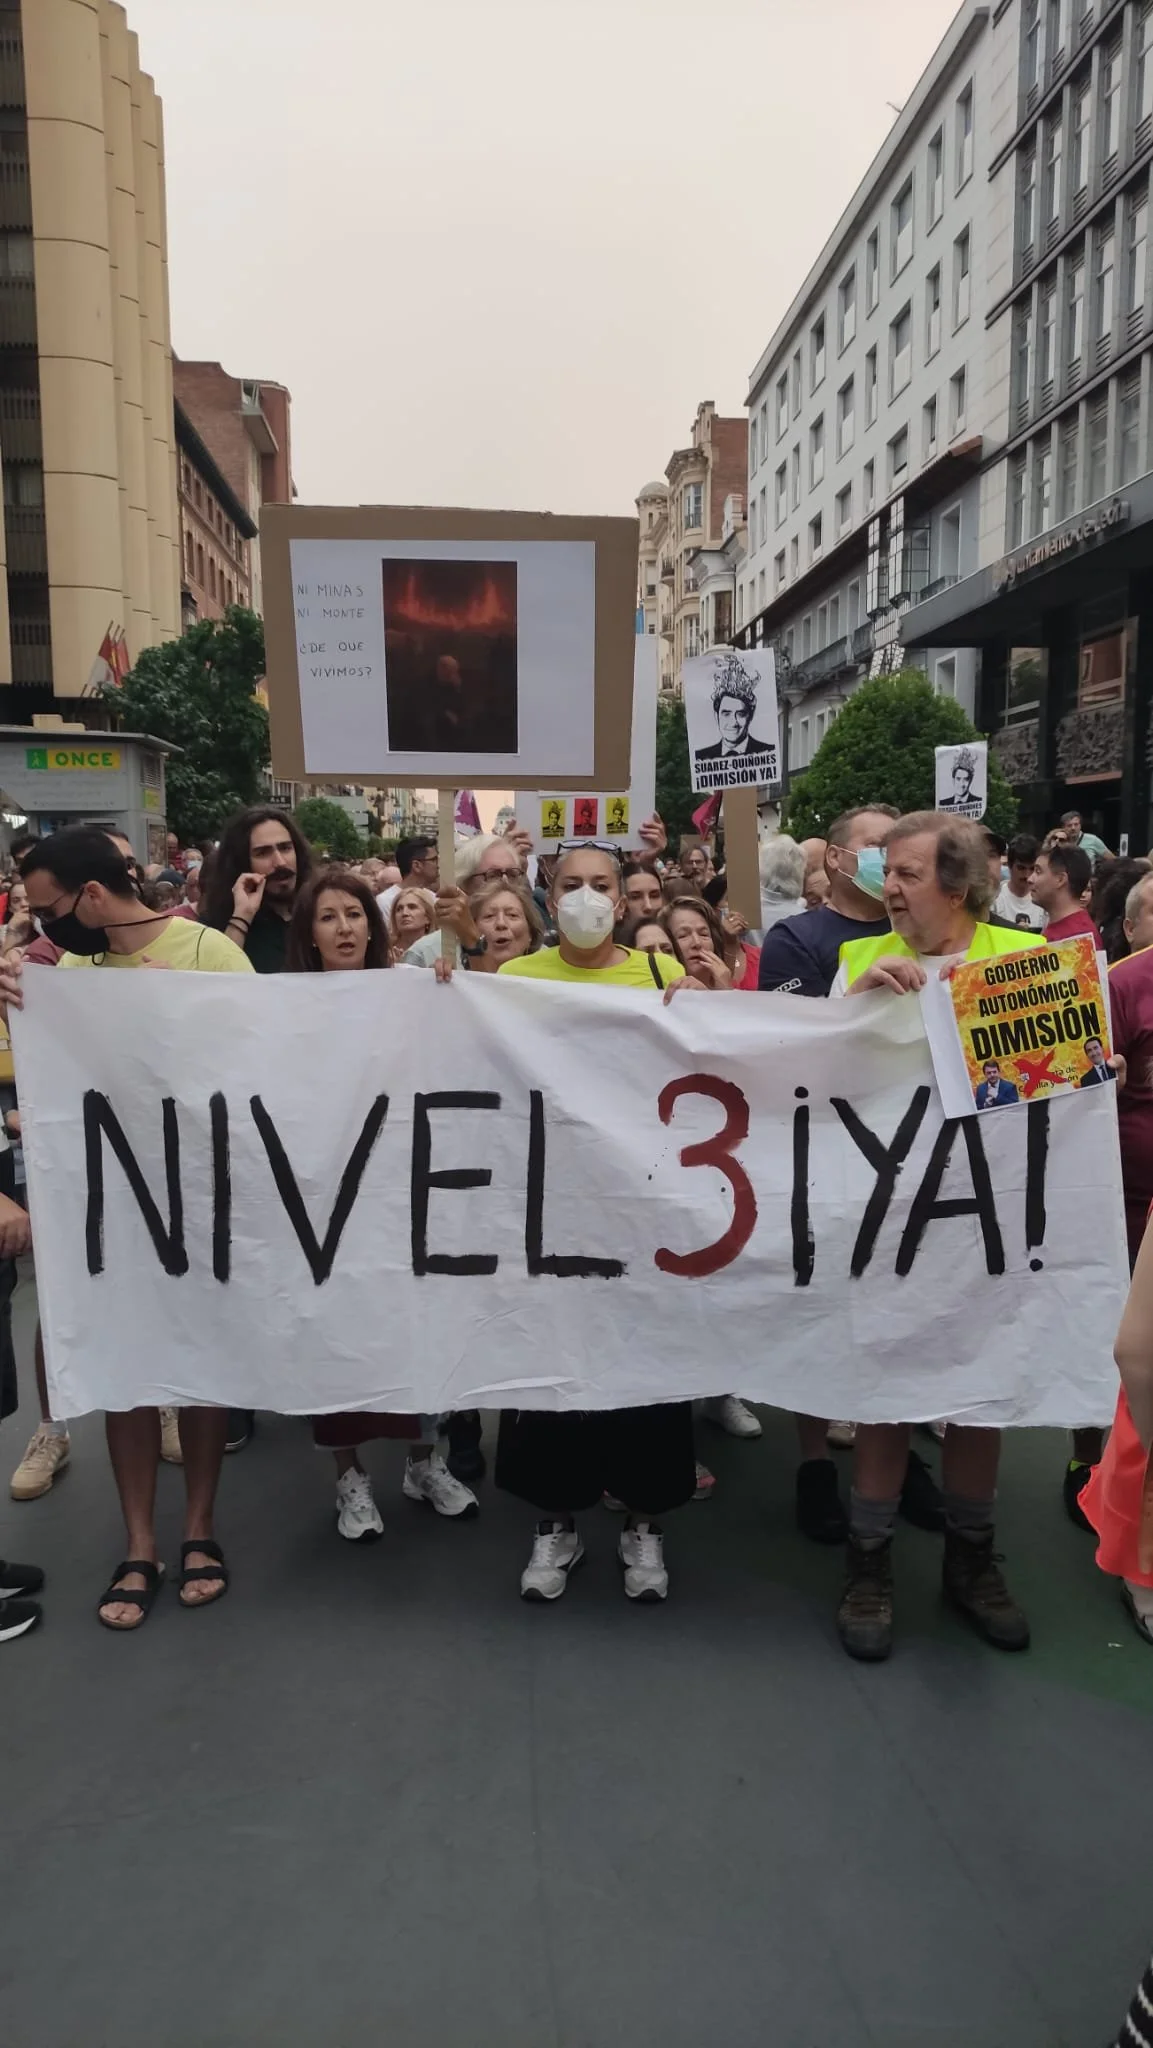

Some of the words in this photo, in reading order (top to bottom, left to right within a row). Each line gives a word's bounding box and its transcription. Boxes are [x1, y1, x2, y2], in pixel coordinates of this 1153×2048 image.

[297, 584, 308, 595] NI
[317, 584, 364, 597] MINAS
[297, 608, 310, 618] NI
[322, 608, 365, 618] MONTE
[299, 642, 326, 654] ¿DE
[310, 666, 372, 678] VIVIMOS?
[55, 752, 113, 766] ONCE
[694, 754, 777, 774] SUAREZ-QUIÑONES
[695, 769, 757, 790] ¡DIMISIÓN
[759, 767, 777, 781] YA!
[984, 952, 1060, 986] GOBIERNO
[978, 978, 1080, 1018] AUTONÓMICO
[970, 998, 1101, 1061] DIMISIÓN
[83, 1088, 627, 1285] NIVEL
[654, 1072, 758, 1278] 3
[790, 1084, 1049, 1287] ¡YA!
